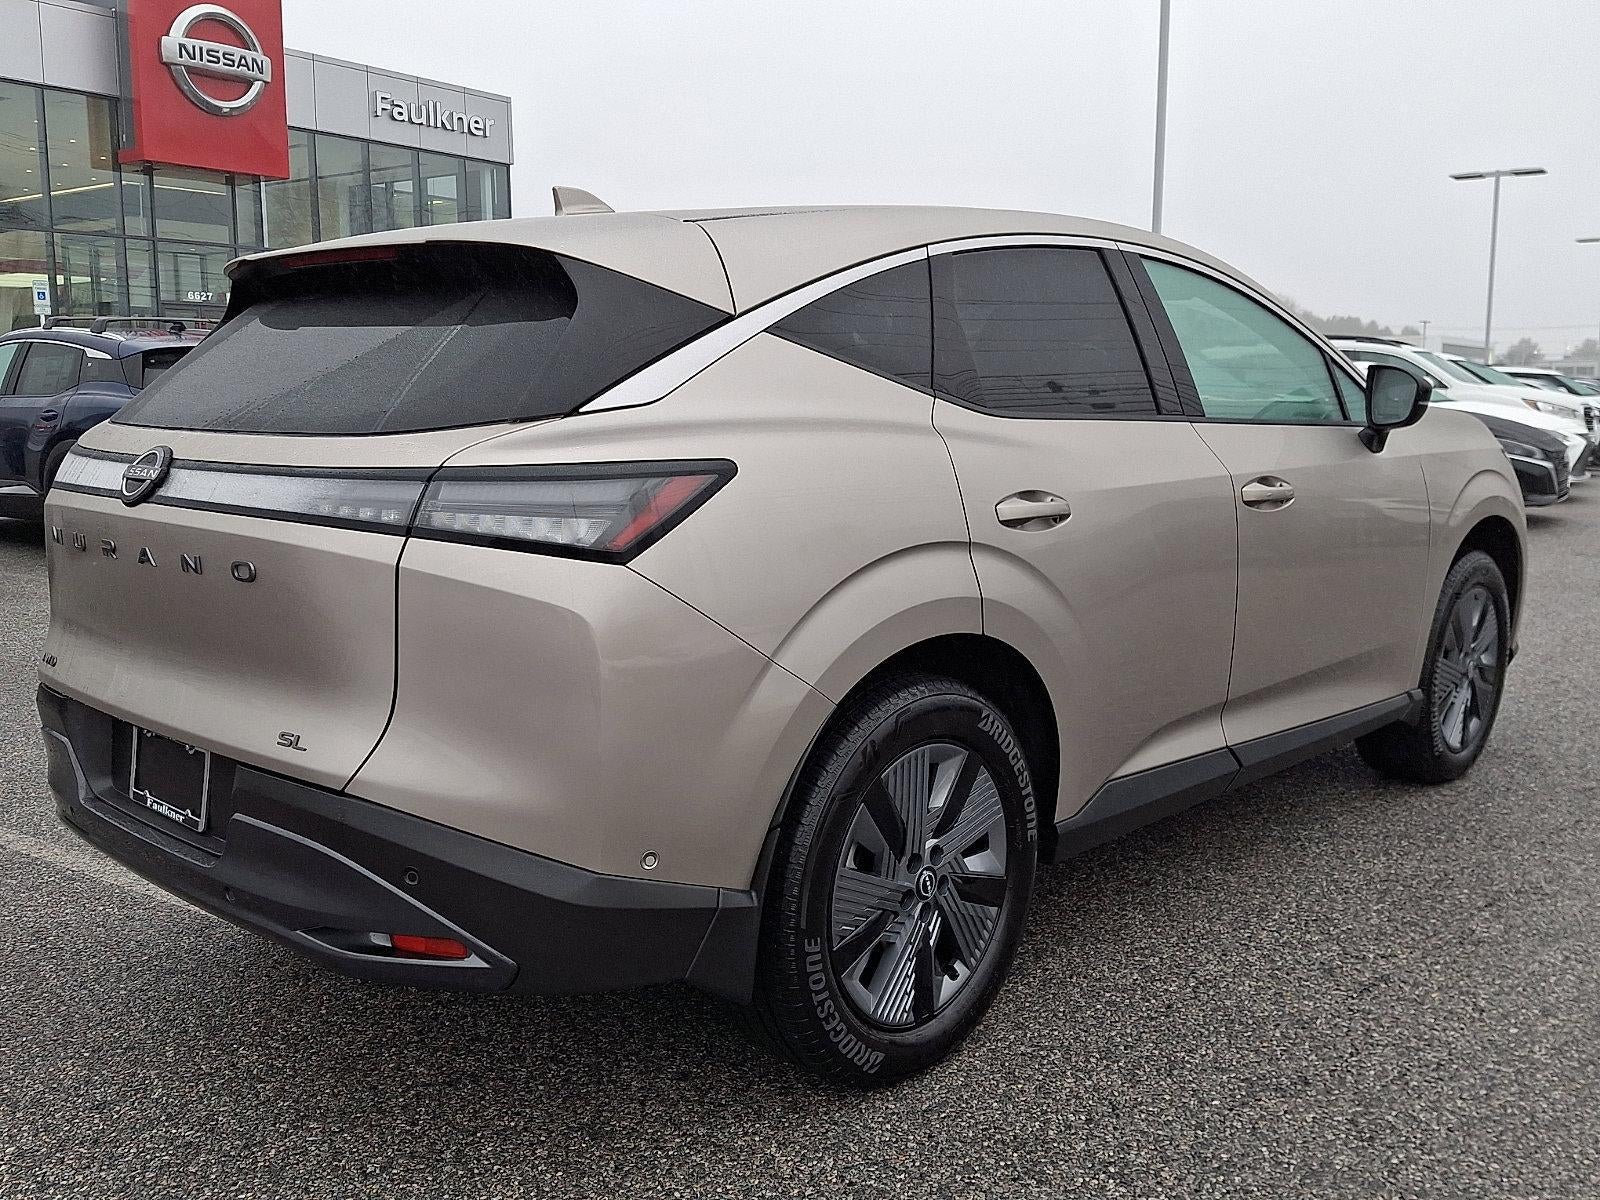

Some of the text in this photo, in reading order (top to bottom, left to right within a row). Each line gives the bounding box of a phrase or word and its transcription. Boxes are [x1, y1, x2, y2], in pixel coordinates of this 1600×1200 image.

[178, 42, 265, 75] NISSAN
[374, 90, 495, 138] Faulkner
[187, 291, 213, 301] 6627
[125, 466, 159, 479] SSAN
[276, 731, 308, 752] SL
[977, 709, 1038, 843] BRIDGESTONE
[146, 797, 186, 823] Faulkner
[804, 936, 886, 1074] BRIDGESTONE
